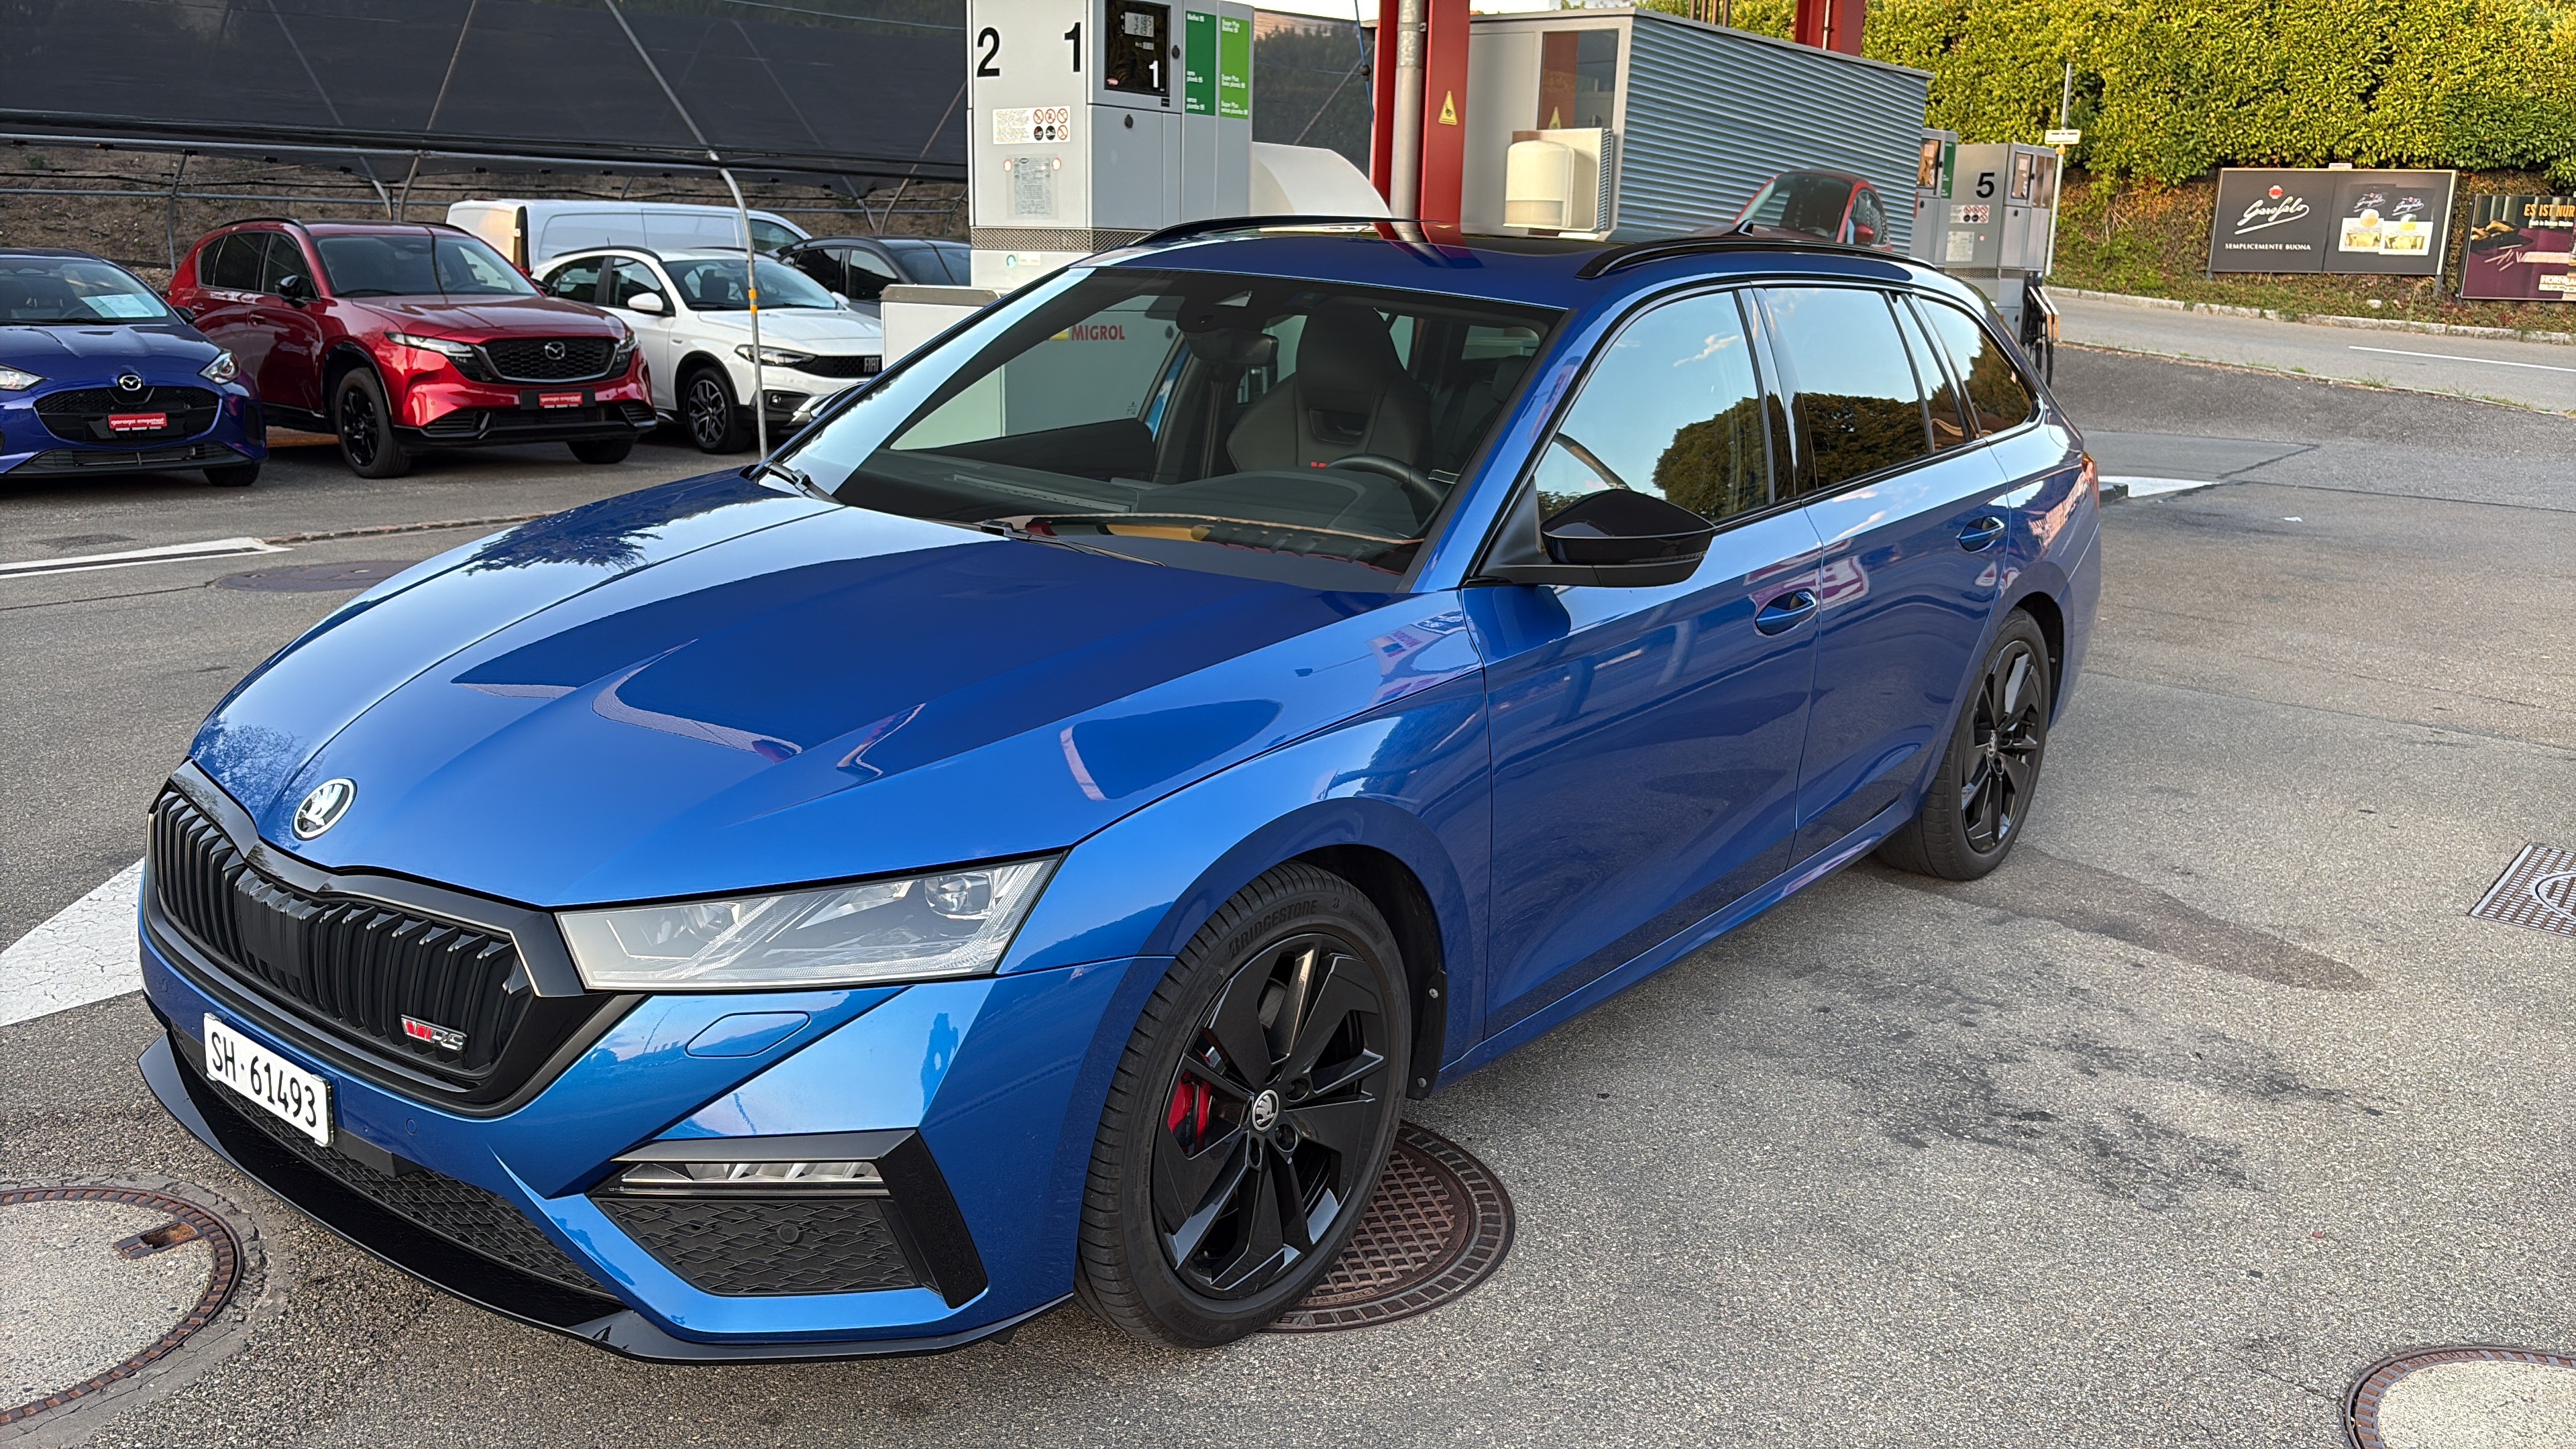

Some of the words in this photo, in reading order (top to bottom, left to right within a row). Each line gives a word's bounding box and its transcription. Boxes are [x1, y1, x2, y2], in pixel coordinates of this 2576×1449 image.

[977, 27, 1000, 77] 2
[1064, 22, 1080, 72] 1
[1148, 60, 1159, 88] 1
[1976, 172, 1995, 199] 5
[2235, 196, 2310, 235] Garofalo
[2524, 203, 2537, 217] ES
[2538, 204, 2555, 217] IST
[2556, 205, 2576, 218] NUR
[2224, 243, 2284, 251] SEMPLICEMENTE
[1071, 325, 1126, 341] MIGROL
[1227, 899, 1318, 960] BRIDGESTONE
